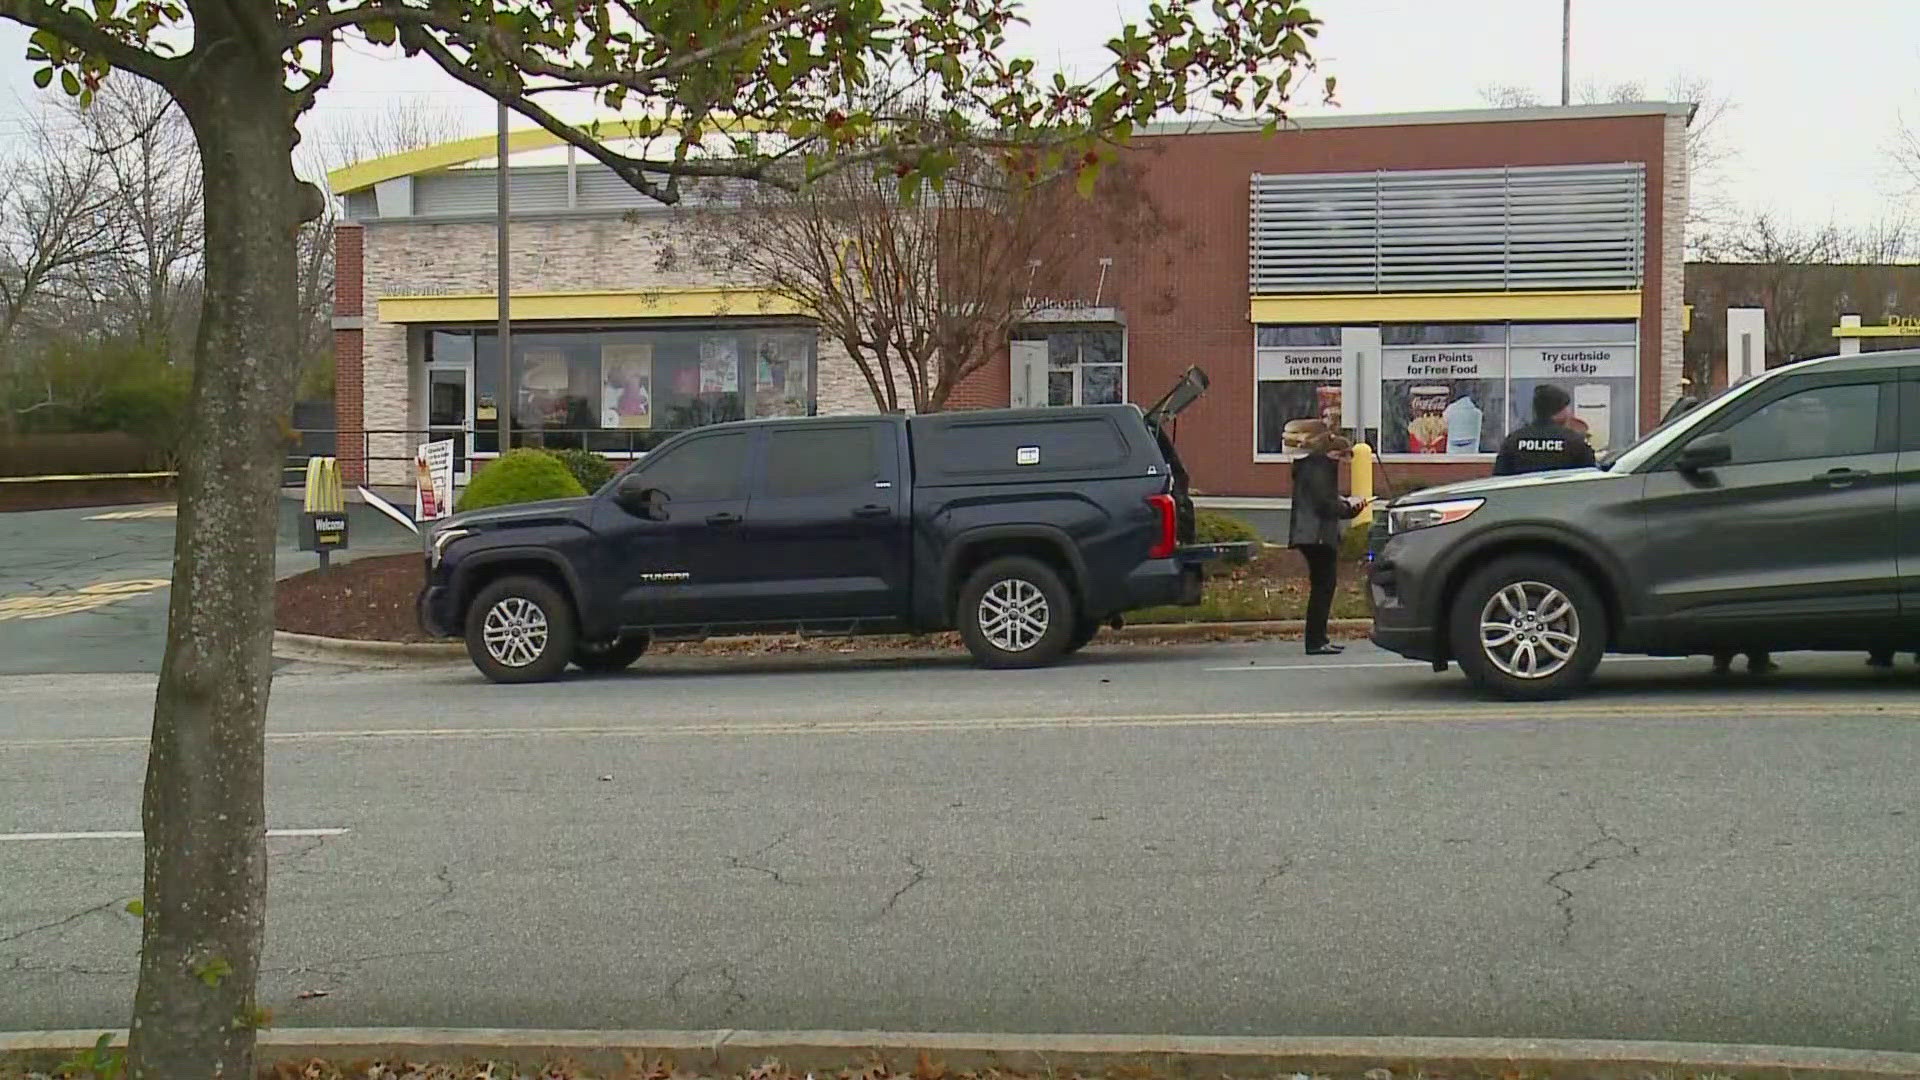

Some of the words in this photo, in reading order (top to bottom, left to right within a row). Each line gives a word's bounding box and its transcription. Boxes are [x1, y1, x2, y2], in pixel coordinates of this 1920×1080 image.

[1888, 314, 1920, 326] Driv
[1284, 355, 1310, 364] Save
[1312, 355, 1342, 364] mone
[1411, 353, 1436, 363] Earn
[1439, 352, 1473, 362] Points
[1542, 351, 1559, 363] Try
[1560, 351, 1611, 361] curbside
[1289, 366, 1300, 376] in
[1302, 366, 1319, 376] the
[1321, 366, 1342, 377] App
[1407, 365, 1422, 374] for
[1424, 365, 1448, 374] Free
[1450, 364, 1478, 374] Food
[1554, 363, 1578, 373] Pick
[1580, 363, 1597, 375] Up
[1517, 440, 1564, 451] POLICE
[640, 571, 690, 580] TUNDRA
